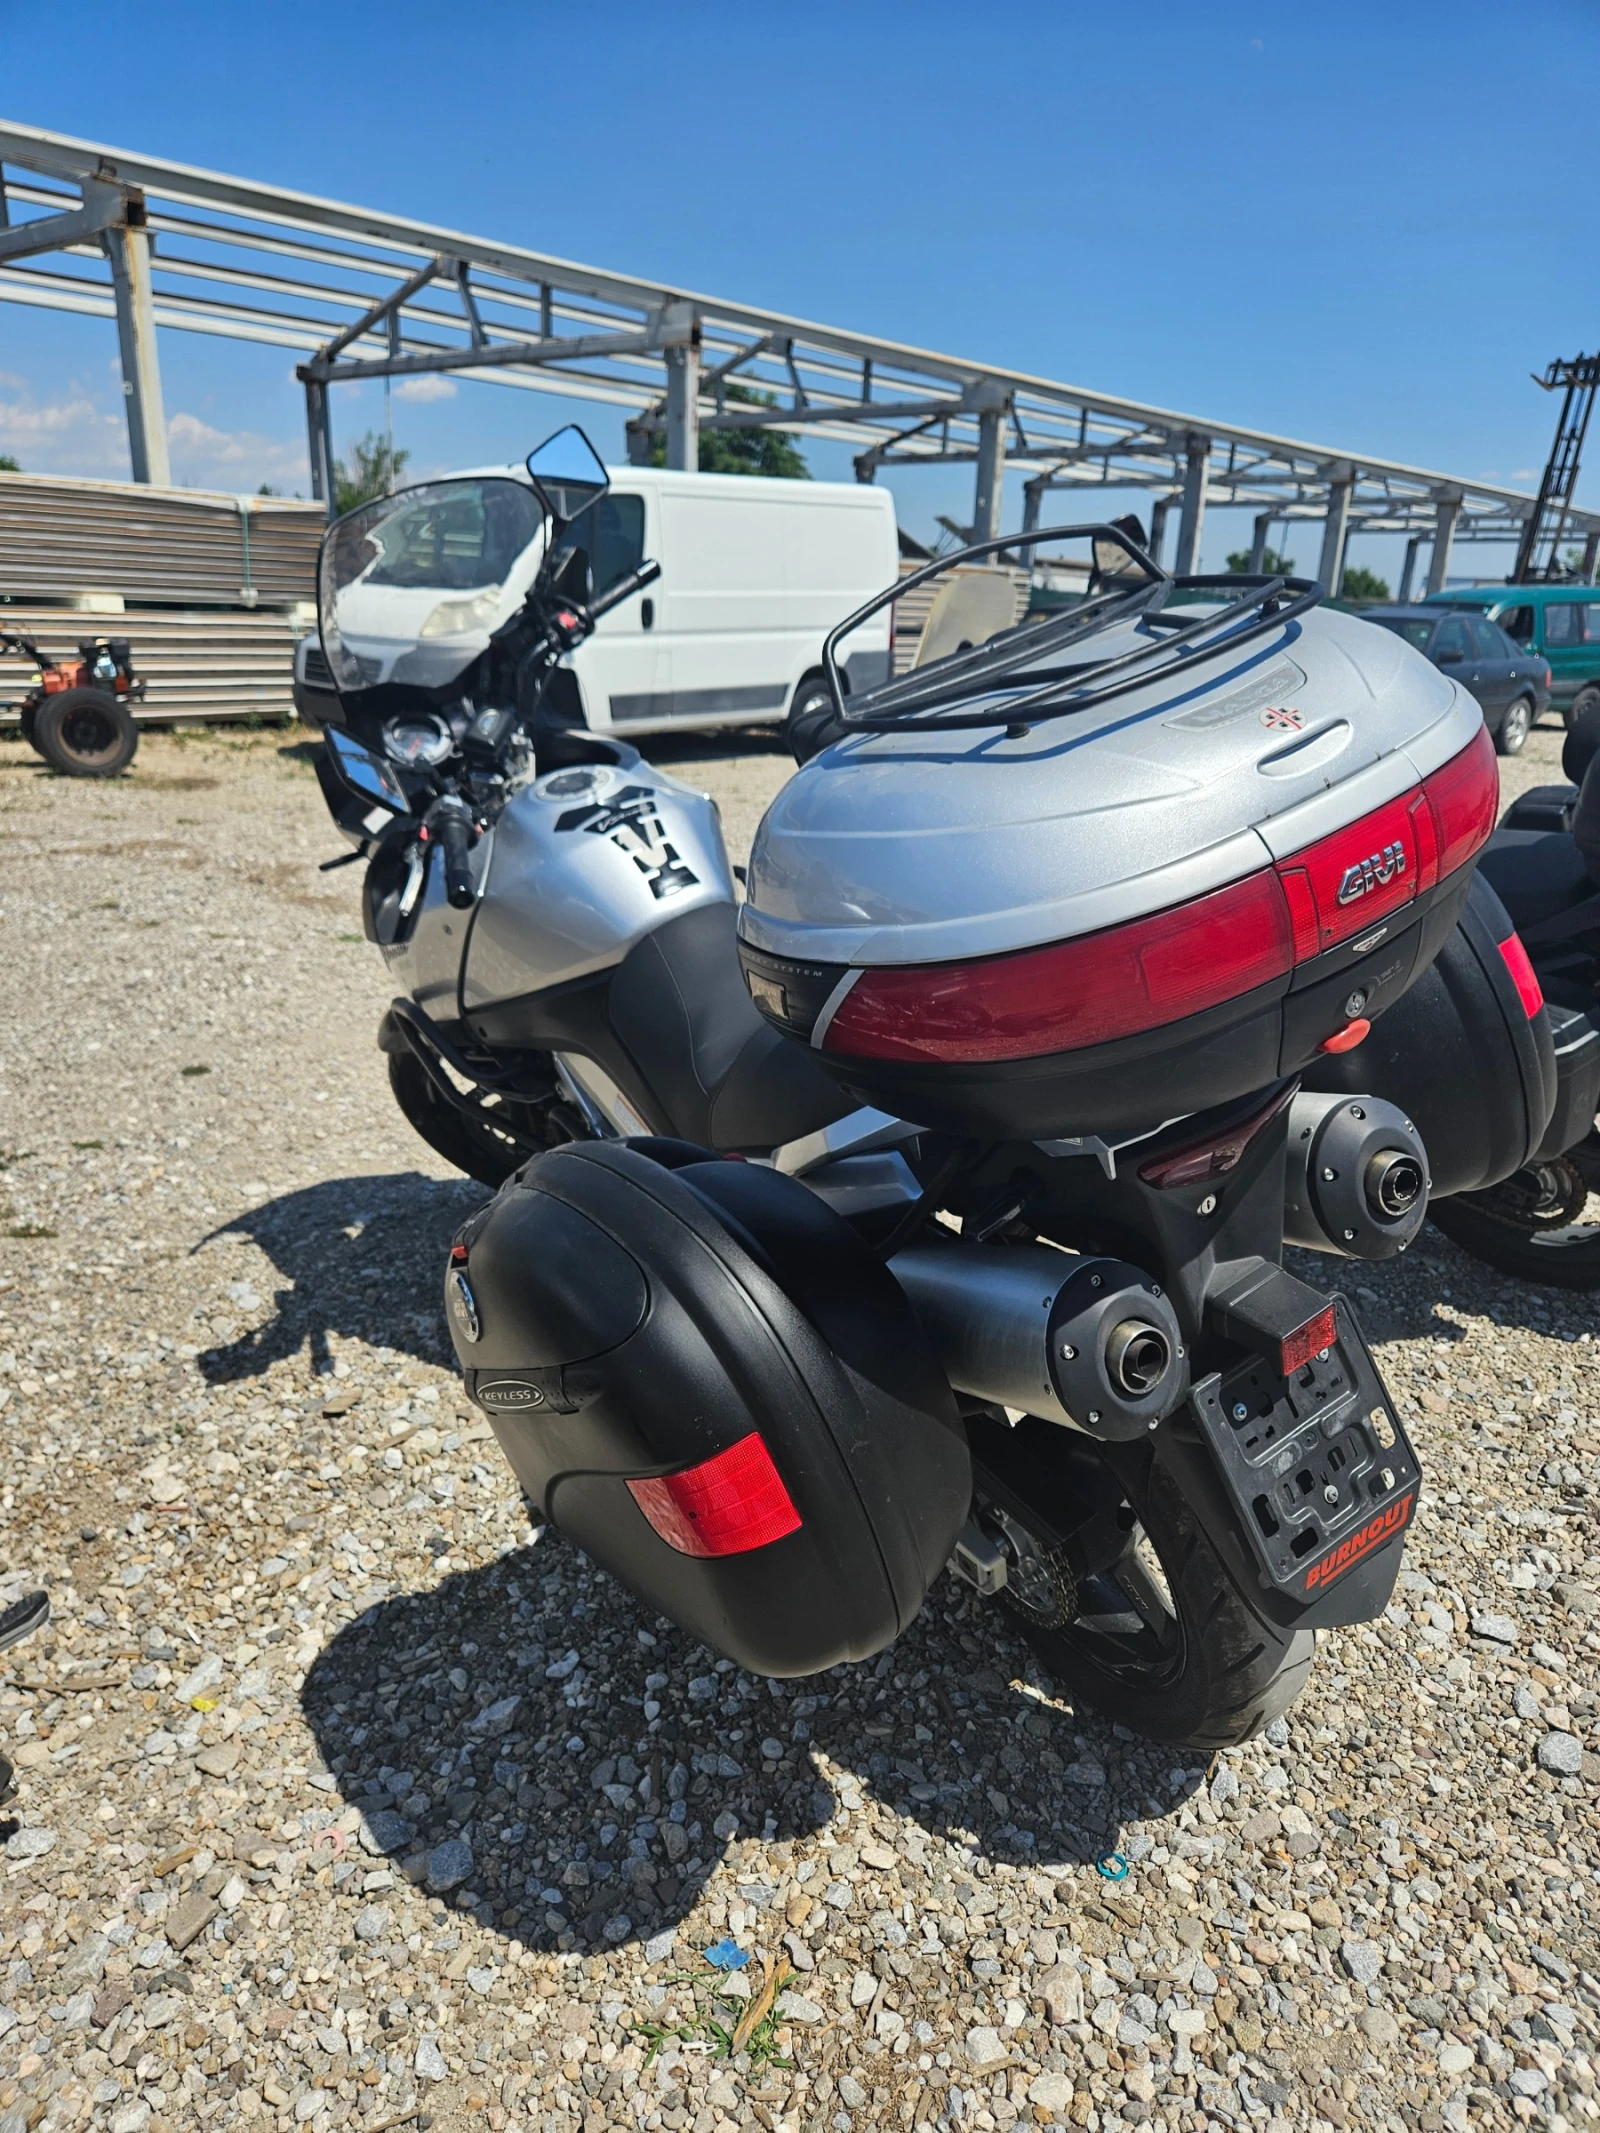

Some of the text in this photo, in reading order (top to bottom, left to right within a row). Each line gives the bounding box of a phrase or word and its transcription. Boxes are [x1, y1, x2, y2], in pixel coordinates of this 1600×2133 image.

[1339, 840, 1406, 905] GIVI
[773, 963, 823, 977] SYSTEM
[484, 1389, 531, 1400] KEYLESS
[1306, 1493, 1414, 1590] BURNOUT
